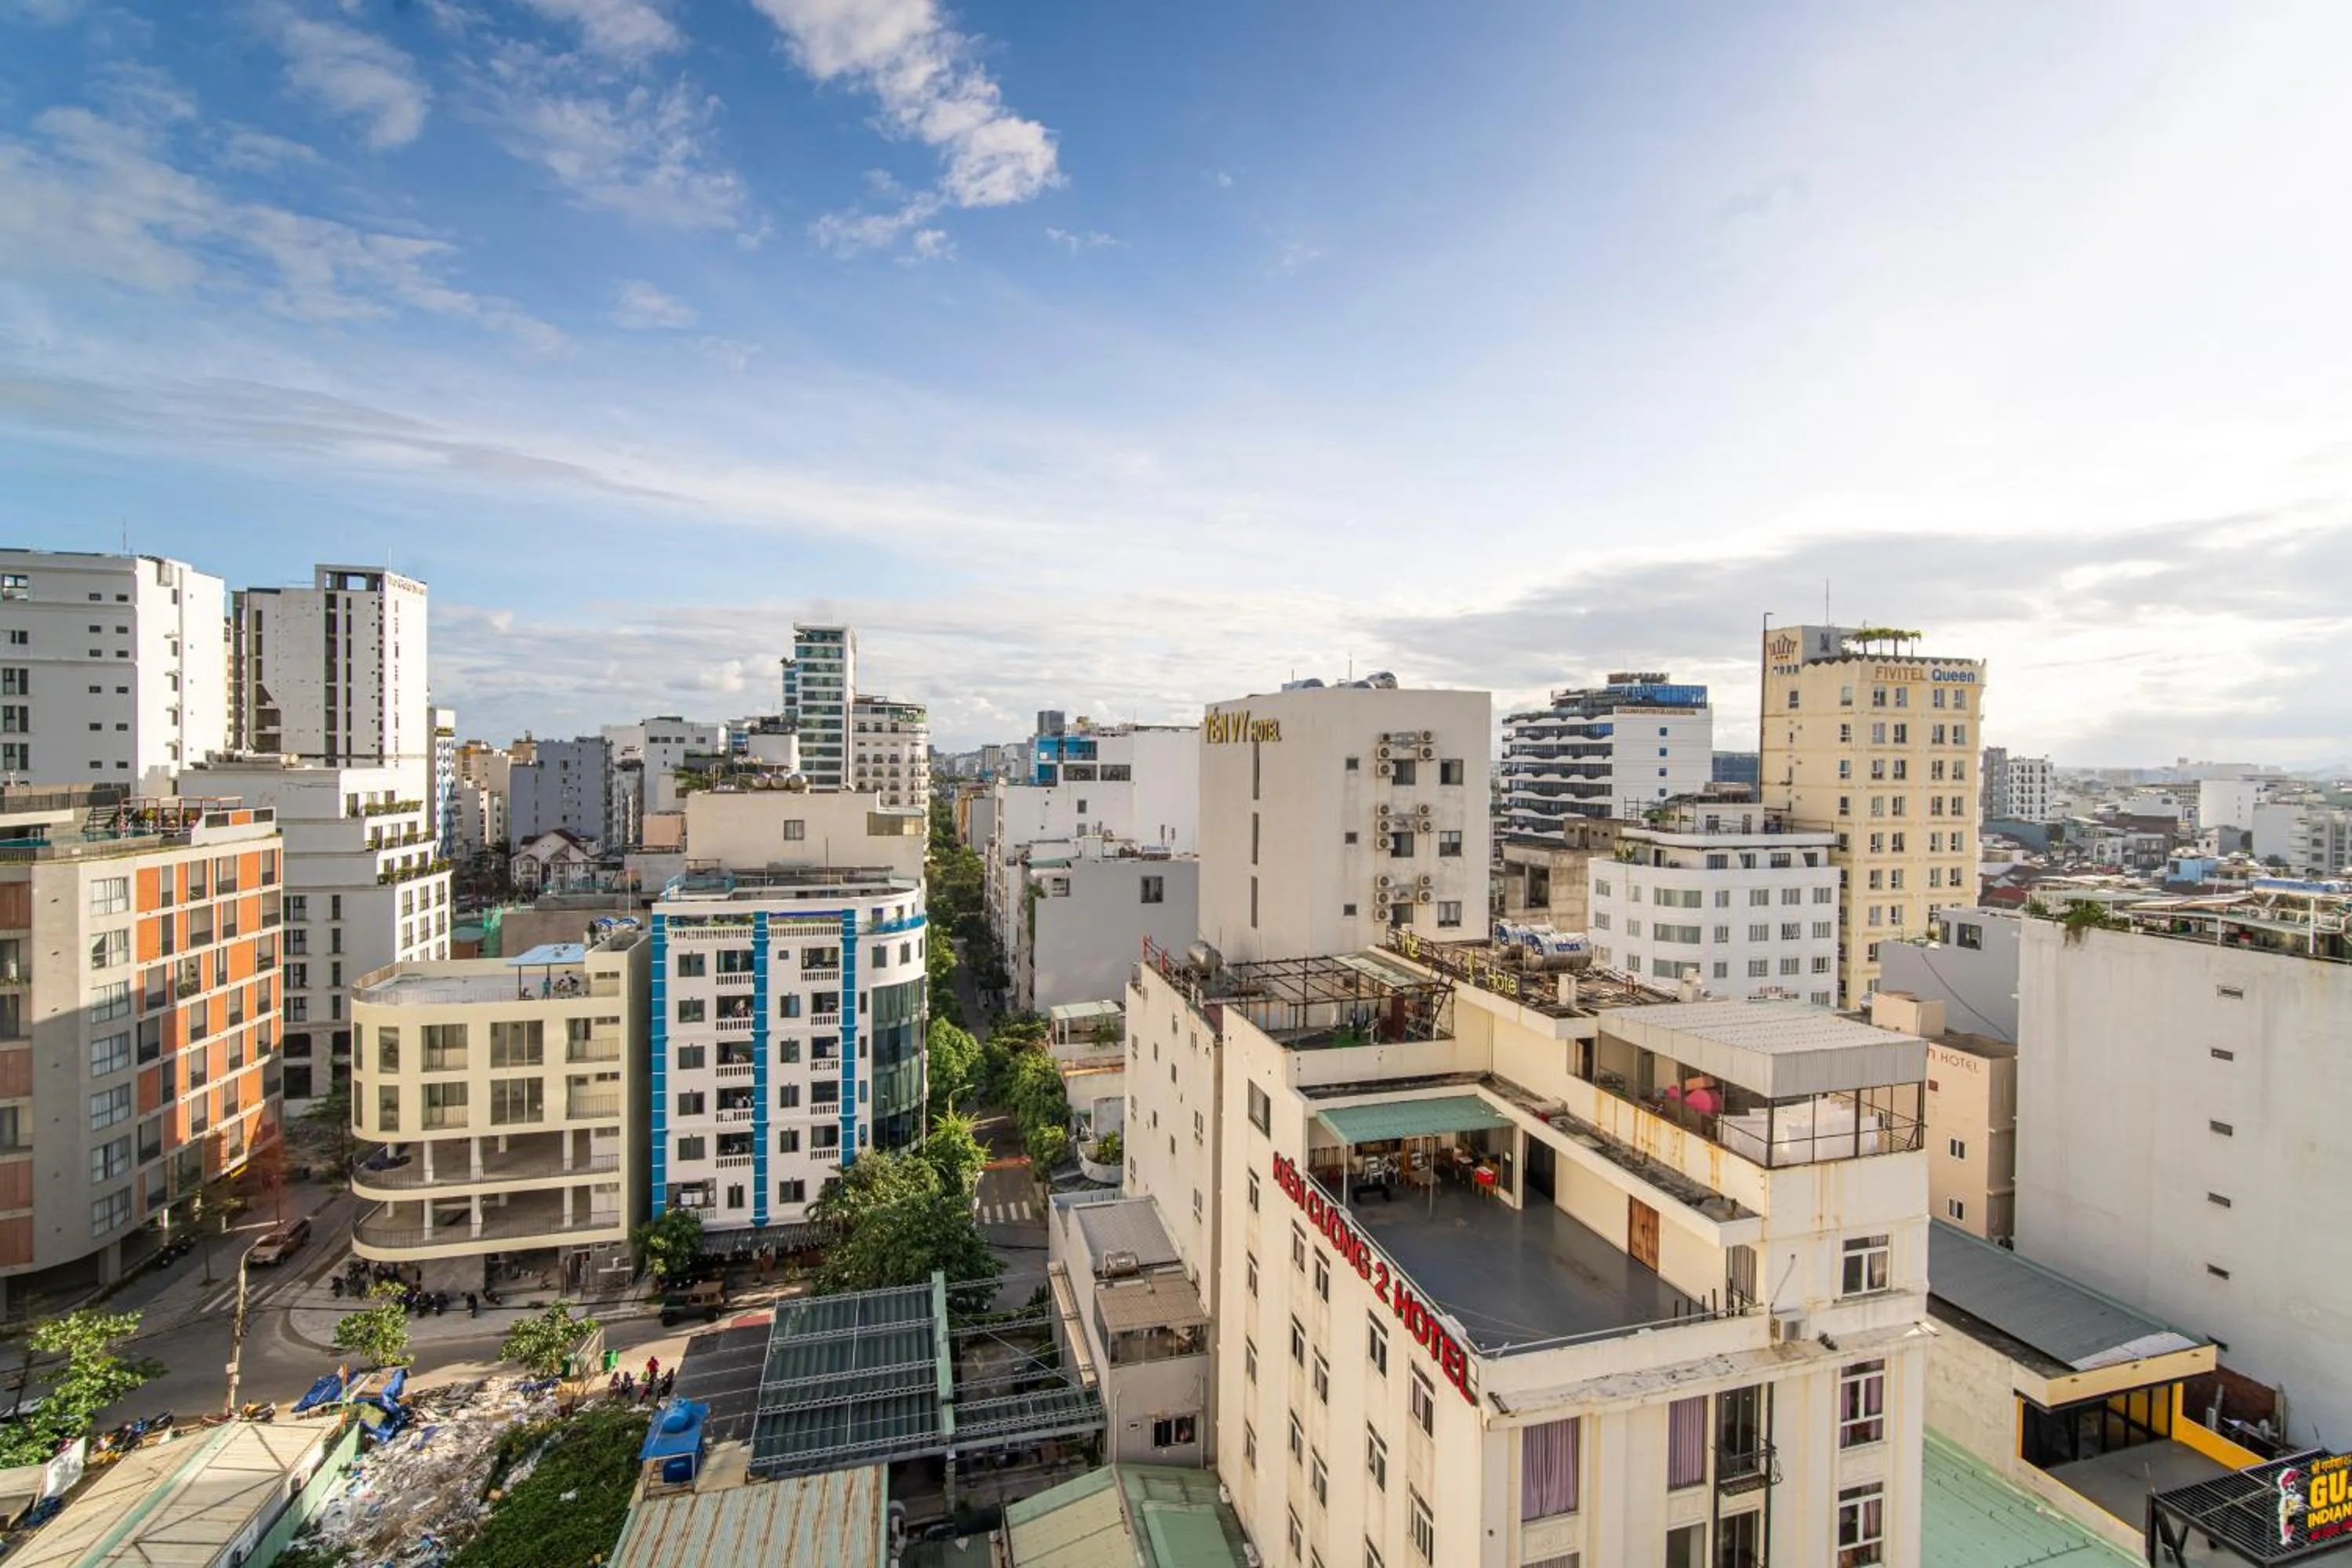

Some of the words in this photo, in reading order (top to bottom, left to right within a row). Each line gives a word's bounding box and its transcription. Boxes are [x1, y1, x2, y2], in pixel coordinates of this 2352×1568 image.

[1875, 666, 1926, 681] FIVITEL
[1932, 669, 1975, 682] Queen
[1230, 710, 1251, 743] VY
[1250, 718, 1281, 742] HOTEL
[1940, 1052, 1980, 1073] HOTEL
[1374, 1261, 1390, 1305] 2
[1394, 1279, 1479, 1406] HOTEL
